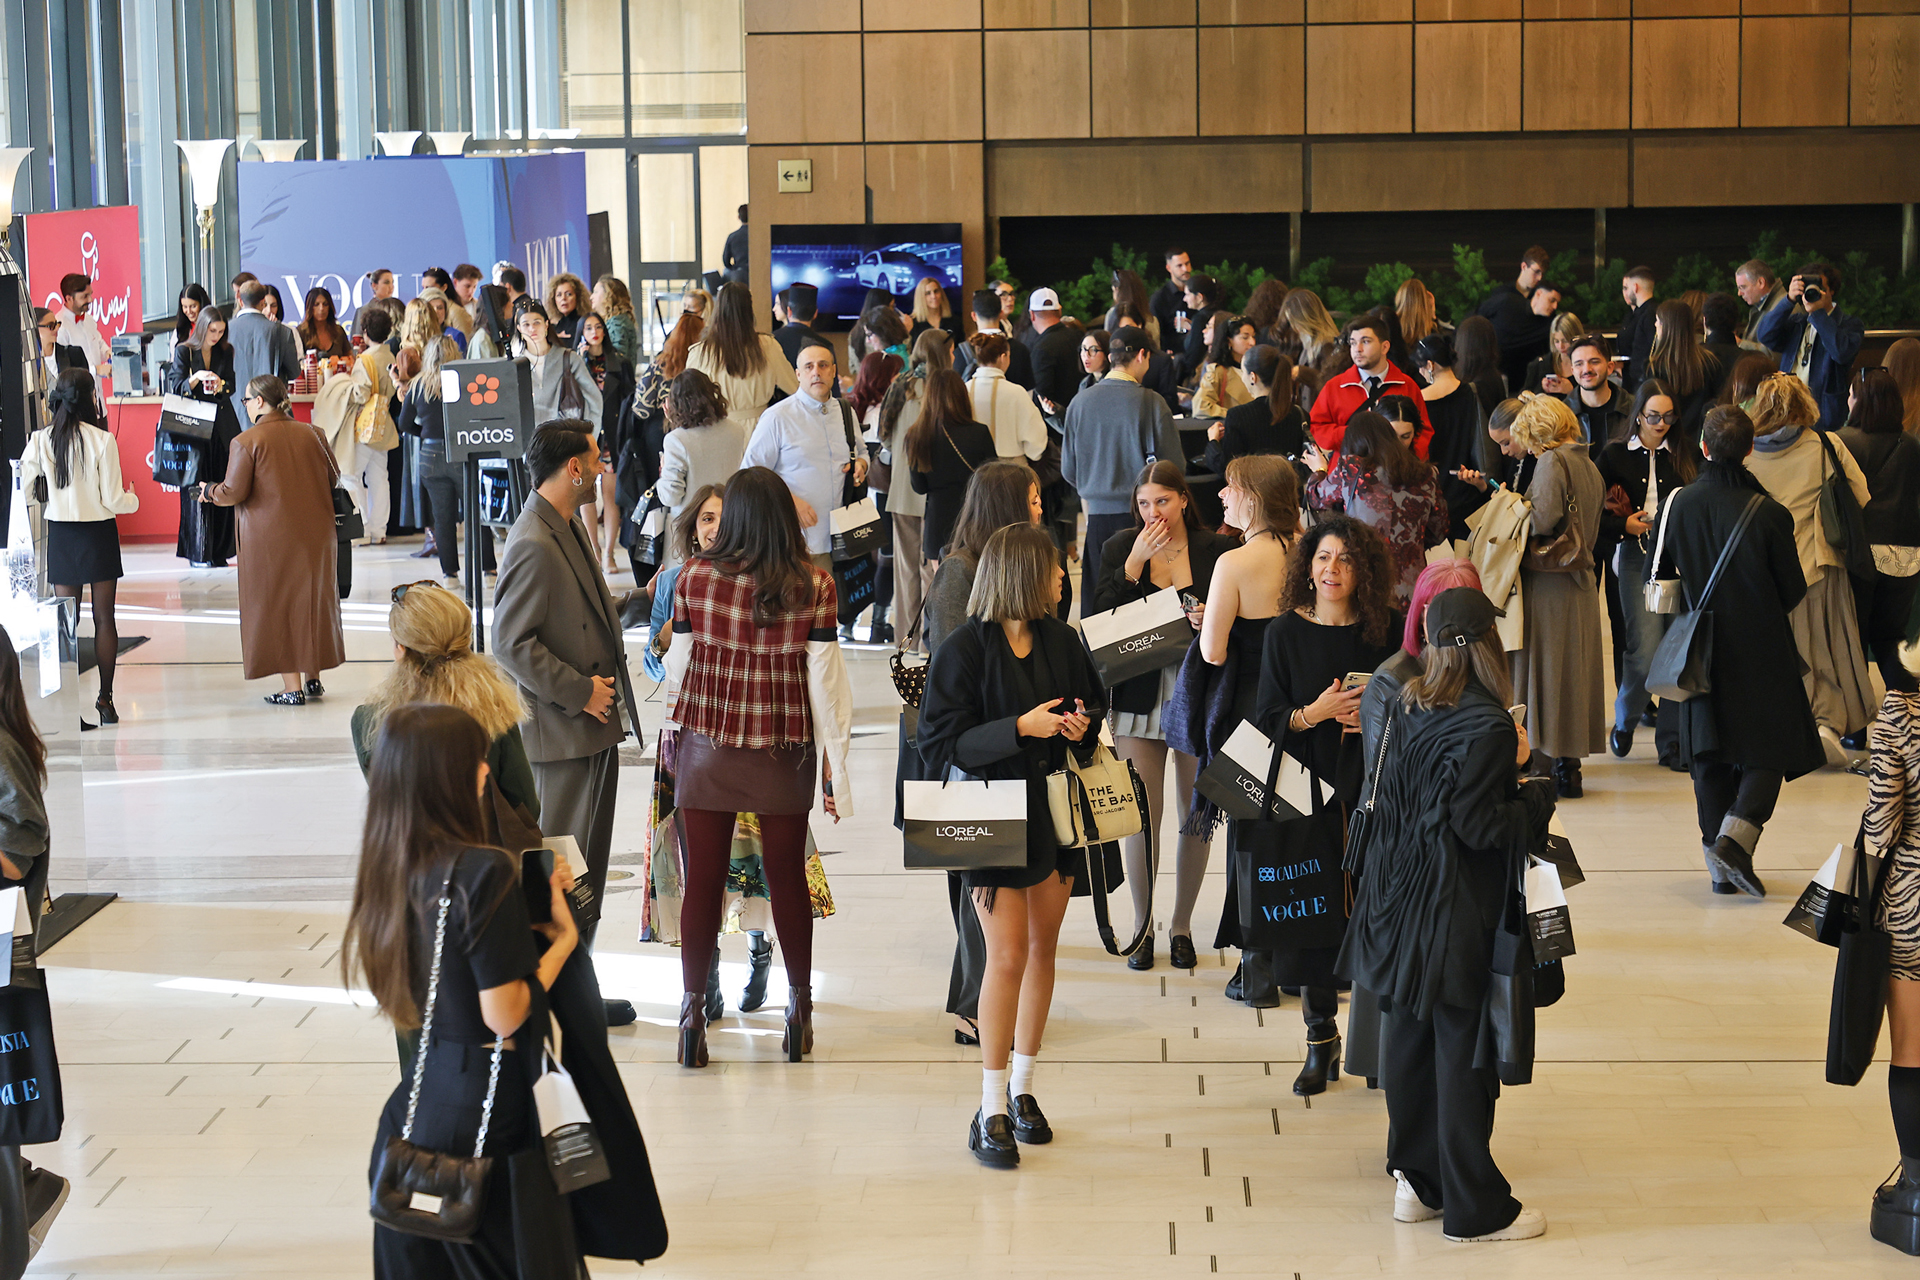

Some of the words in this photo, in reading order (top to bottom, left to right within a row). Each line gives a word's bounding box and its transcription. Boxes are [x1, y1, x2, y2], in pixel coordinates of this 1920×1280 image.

[457, 426, 514, 446] notos
[1118, 632, 1165, 655] L'ORÉAL
[1135, 644, 1153, 653] PARIS
[1089, 785, 1114, 798] THE
[1246, 793, 1263, 808] PARIS
[1073, 798, 1106, 813] TTE
[1109, 793, 1134, 806] BAG
[936, 825, 994, 837] L'ORÉAL
[1276, 858, 1321, 881] CALLISTA
[1261, 896, 1327, 922] VOGUE
[0, 1077, 40, 1106] GUE
